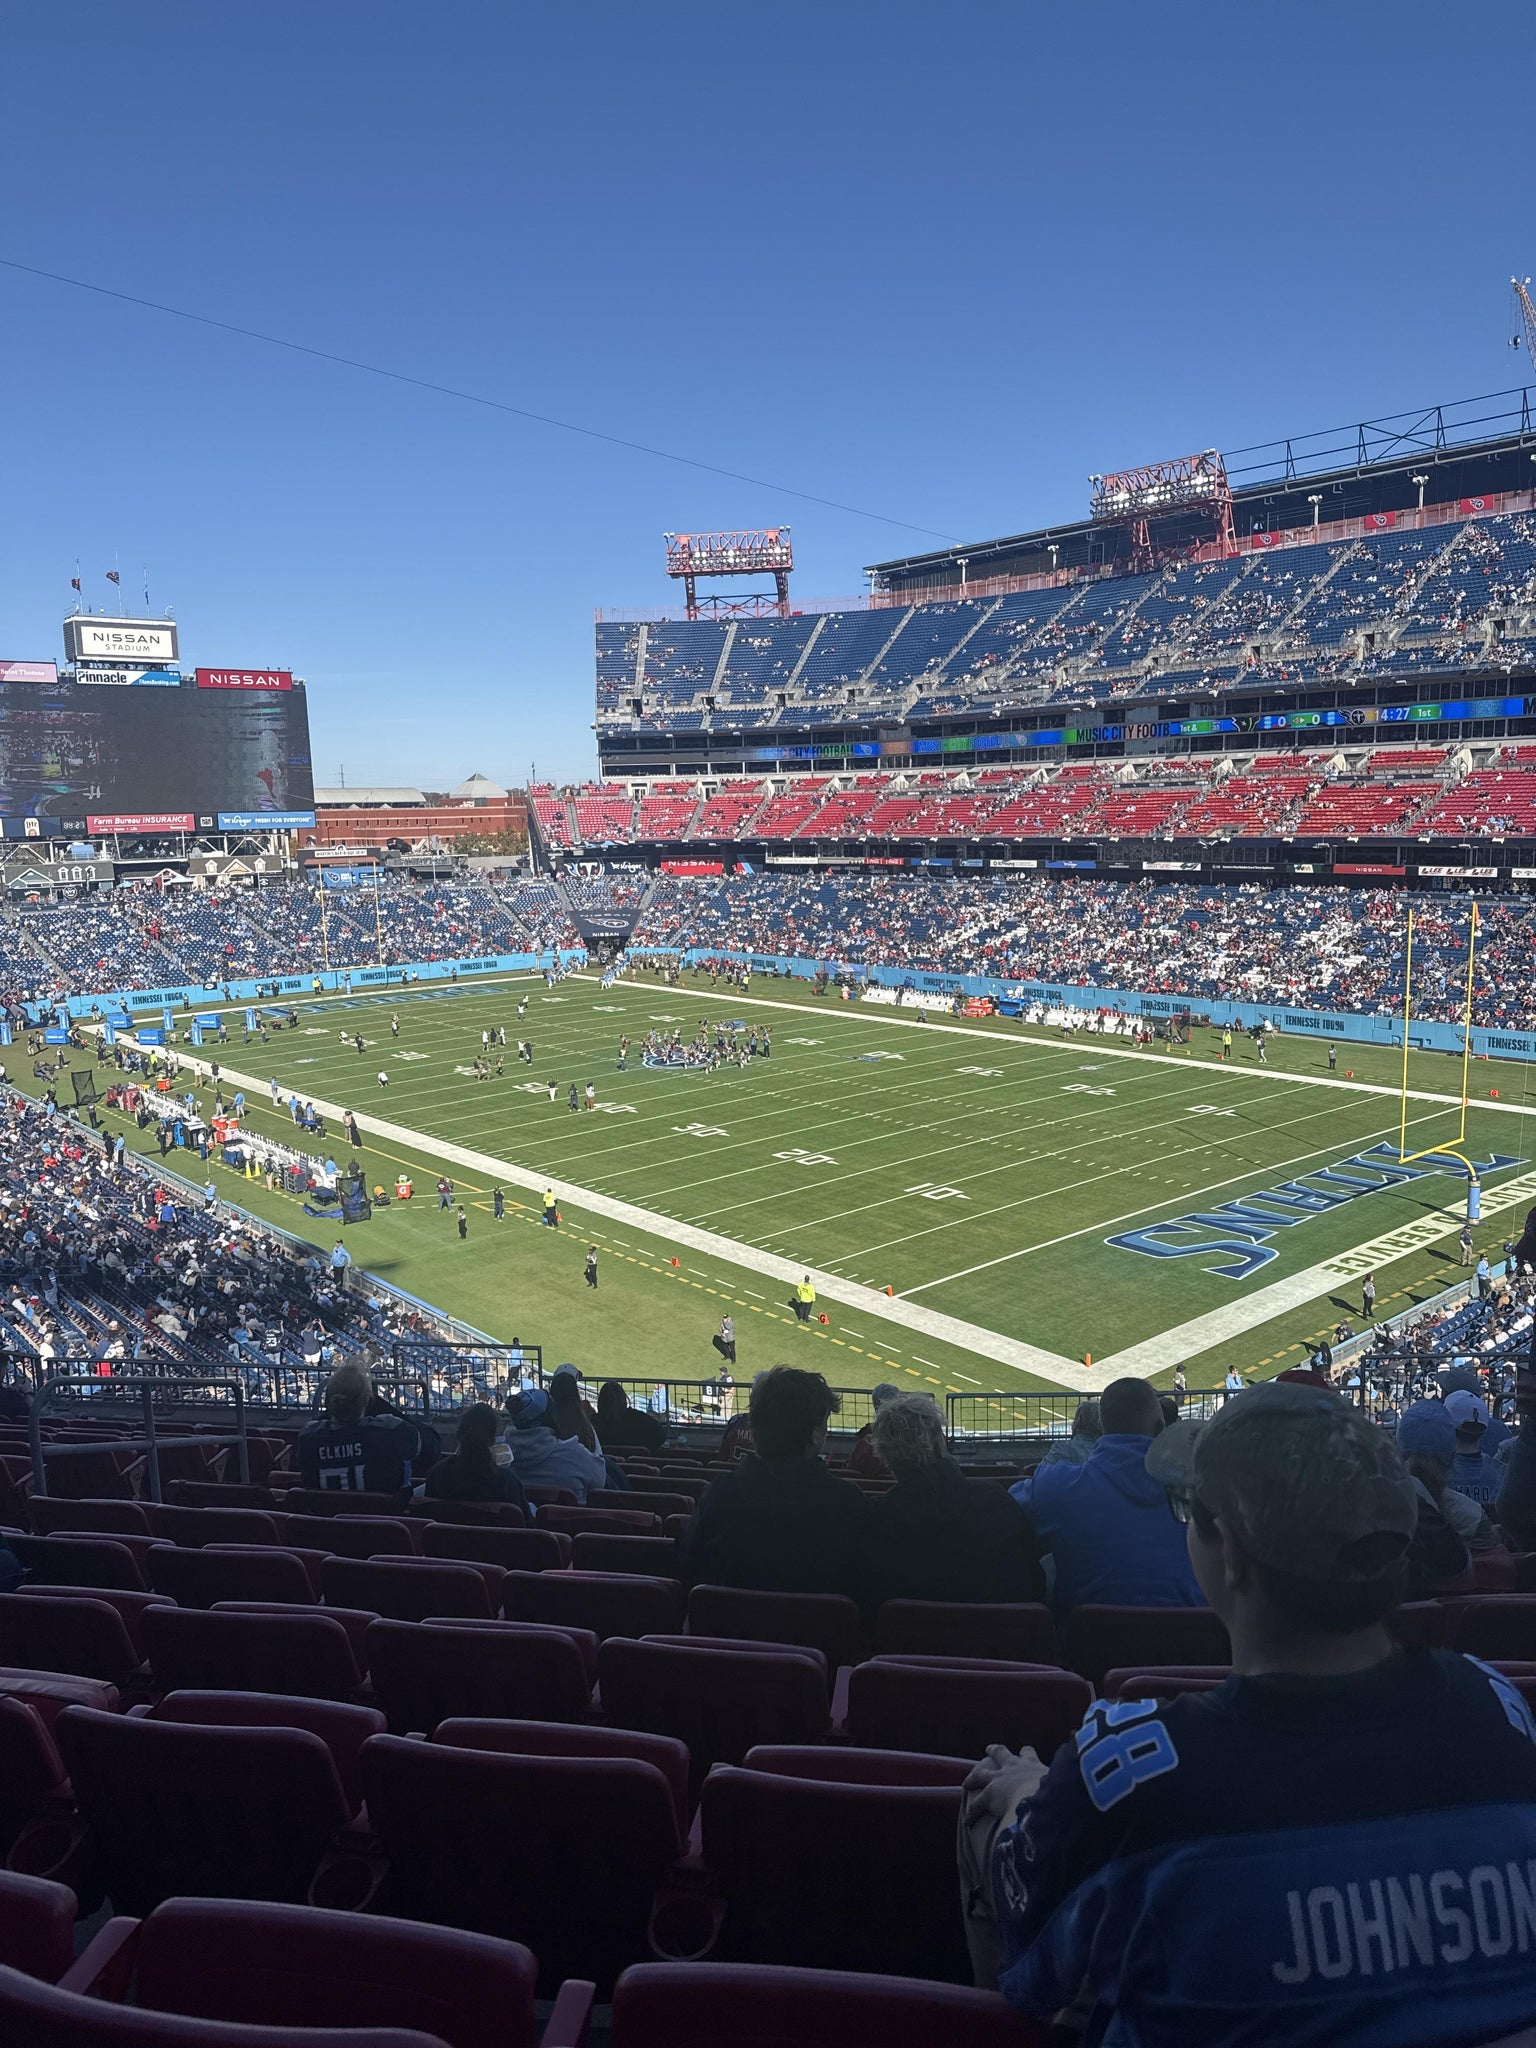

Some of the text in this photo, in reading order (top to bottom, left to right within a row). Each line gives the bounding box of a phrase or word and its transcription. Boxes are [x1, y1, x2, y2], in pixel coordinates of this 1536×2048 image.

[93, 632, 161, 645] NISSAN
[105, 643, 150, 652] STADIUM
[78, 670, 127, 683] Pinnacle
[209, 673, 280, 686] NISSAN
[1418, 708, 1431, 717] 1st
[1277, 716, 1286, 727] 0
[1311, 714, 1321, 725] 0
[1076, 723, 1170, 743] MUSIC CITY FOOTB
[1180, 724, 1190, 732] 1st
[93, 817, 113, 825] Farm
[114, 817, 140, 825] Bureau
[620, 860, 642, 873] Kroger
[460, 960, 498, 971] TENNESSEE TOUGH
[360, 969, 401, 981] TENNESSEE TOUG
[285, 980, 302, 989] TOUGH
[132, 991, 183, 1005] TENNESSEE TOUGH
[1140, 1000, 1170, 1011] TENNESSEE
[1285, 1015, 1345, 1031] TENNESSEE TOUGH
[1487, 1037, 1530, 1052] TENNESSEE
[1059, 1084, 1117, 1096] 20
[1185, 1104, 1237, 1117] 10
[671, 1122, 727, 1137] 30
[771, 1148, 835, 1166] 20
[399, 1186, 407, 1195] G
[903, 1182, 965, 1200] 10
[1104, 1140, 1532, 1281] TITANS
[1321, 1225, 1444, 1277] SERVICE
[266, 1337, 277, 1347] 23
[319, 1442, 362, 1460] ELKINS
[1272, 1857, 1536, 1985] JOHNSON
